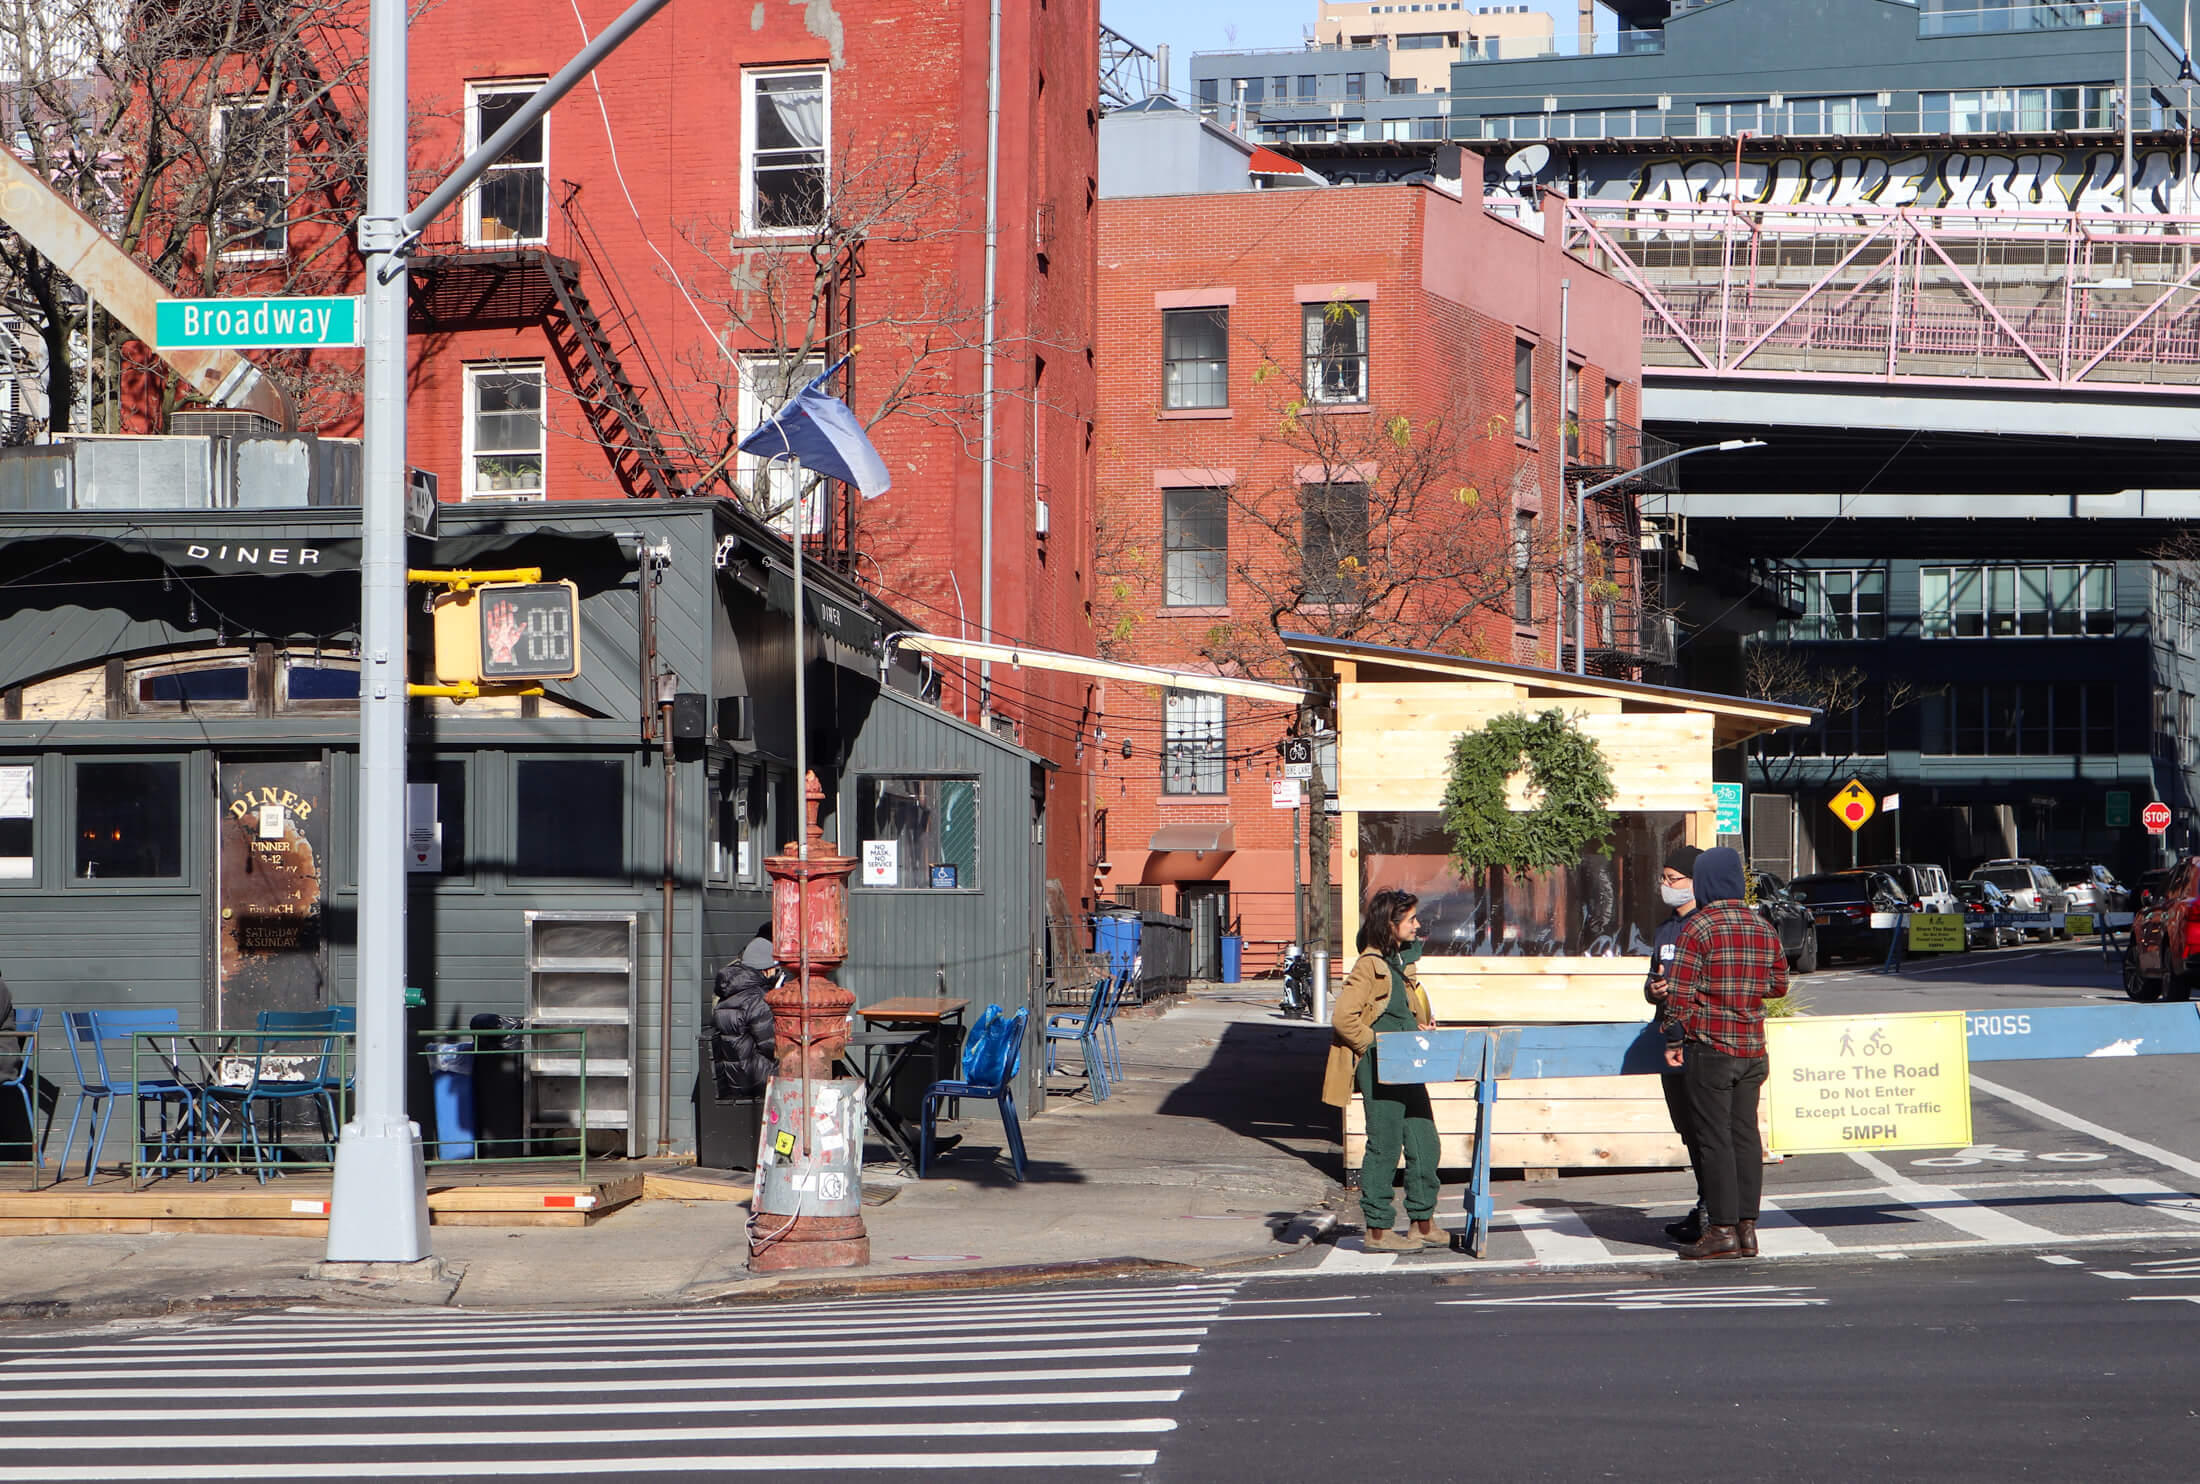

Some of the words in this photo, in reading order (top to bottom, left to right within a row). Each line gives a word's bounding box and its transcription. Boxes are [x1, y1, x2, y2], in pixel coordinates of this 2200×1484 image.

[184, 302, 331, 342] Broadway
[416, 489, 430, 519] WAY
[187, 545, 320, 565] DINER
[821, 603, 841, 627] DINER
[229, 787, 313, 820] DINER
[2145, 811, 2169, 823] STOP
[251, 842, 290, 851] DINNER
[246, 928, 298, 937] SATURDAY
[1966, 1015, 2032, 1036] CROSS
[1793, 1067, 1846, 1082] Share
[1853, 1065, 1886, 1080] The
[1894, 1063, 1940, 1078] Road
[1820, 1088, 1839, 1100] Do
[1844, 1087, 1870, 1099] Not
[1876, 1086, 1915, 1098] Enter
[1795, 1107, 1846, 1119] Except
[1851, 1104, 1890, 1117] Local
[1895, 1102, 1941, 1115] Traffic
[1842, 1124, 1897, 1140] 5MPH
